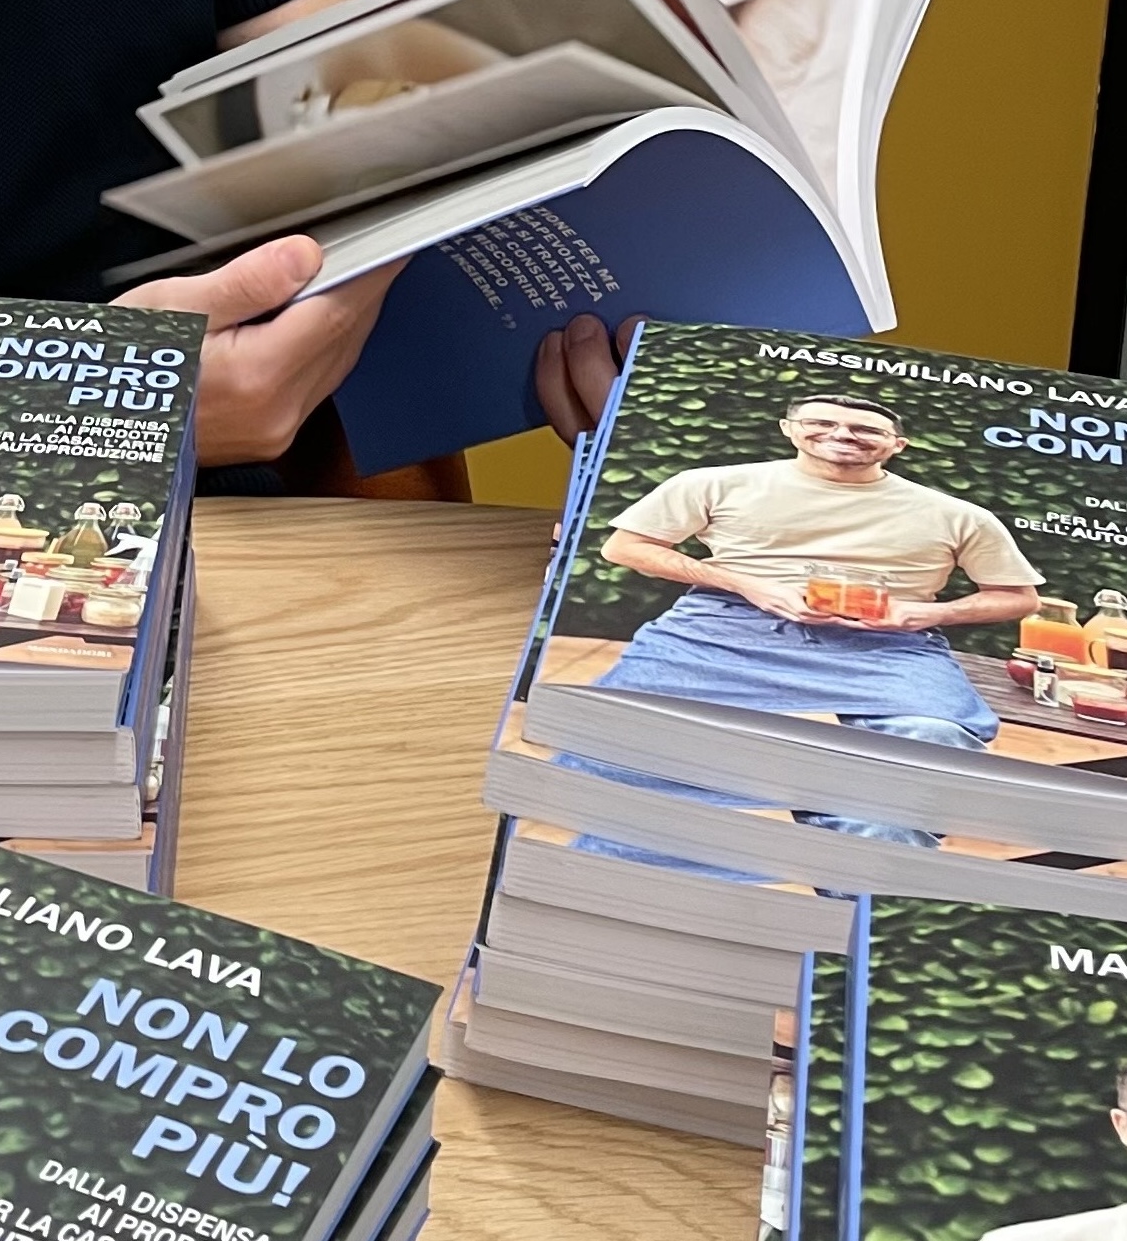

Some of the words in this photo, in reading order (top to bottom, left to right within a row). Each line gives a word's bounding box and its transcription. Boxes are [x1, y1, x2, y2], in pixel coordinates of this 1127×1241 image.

[466, 245, 509, 287] TEMPO
[472, 234, 546, 309] RISCOPRIRE
[506, 241, 568, 311] CONSERVE
[516, 230, 535, 242] SI
[532, 243, 576, 292] TRATTA
[572, 239, 601, 265] PER
[596, 267, 621, 293] ME
[24, 315, 104, 333] LAVA
[123, 345, 185, 367] LO
[758, 343, 1034, 396] MASSIMILIANO
[68, 386, 175, 412] PIÙ!
[19, 432, 42, 443] LA
[104, 438, 166, 453] L'ARTE
[20, 412, 77, 425] DALLA
[81, 416, 170, 433] DISPENSA
[53, 425, 73, 434] AI
[77, 426, 168, 442] PRODOTTI
[983, 426, 1123, 466] COM
[1046, 511, 1088, 528] PER
[1093, 519, 1121, 534] LA
[143, 937, 263, 997] LAVA
[1049, 945, 1127, 980] MA
[75, 977, 249, 1062] NON
[260, 1037, 367, 1099] LO
[131, 1114, 313, 1209] PIÙ!
[38, 1159, 128, 1206] DALLA
[15, 1207, 53, 1238] LA
[77, 1203, 113, 1228] AI
